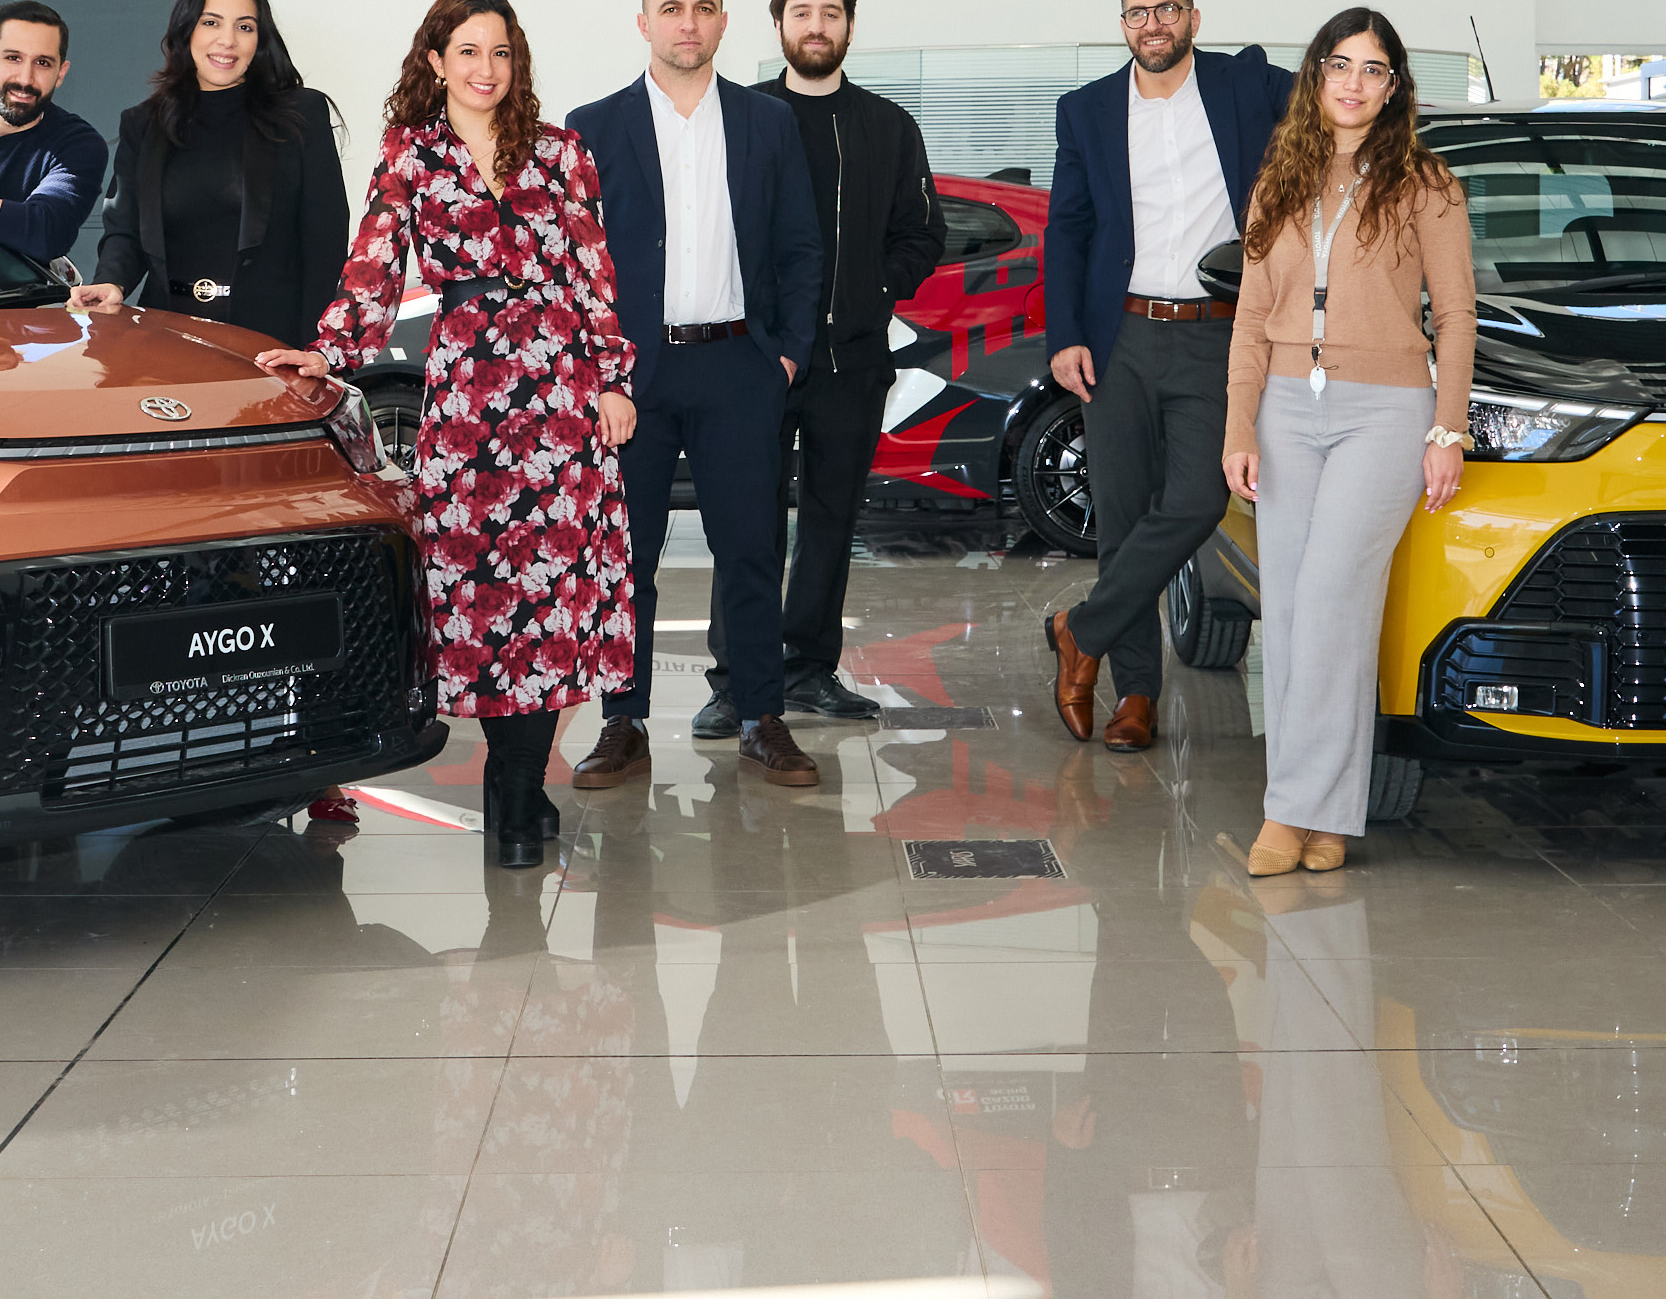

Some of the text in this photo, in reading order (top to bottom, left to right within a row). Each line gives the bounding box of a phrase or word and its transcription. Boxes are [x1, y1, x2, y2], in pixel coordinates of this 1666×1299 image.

[188, 622, 276, 659] AYGO X
[165, 676, 209, 693] TOYOTA
[222, 662, 315, 685] Dickran Ouzounian & Co. Ltd.
